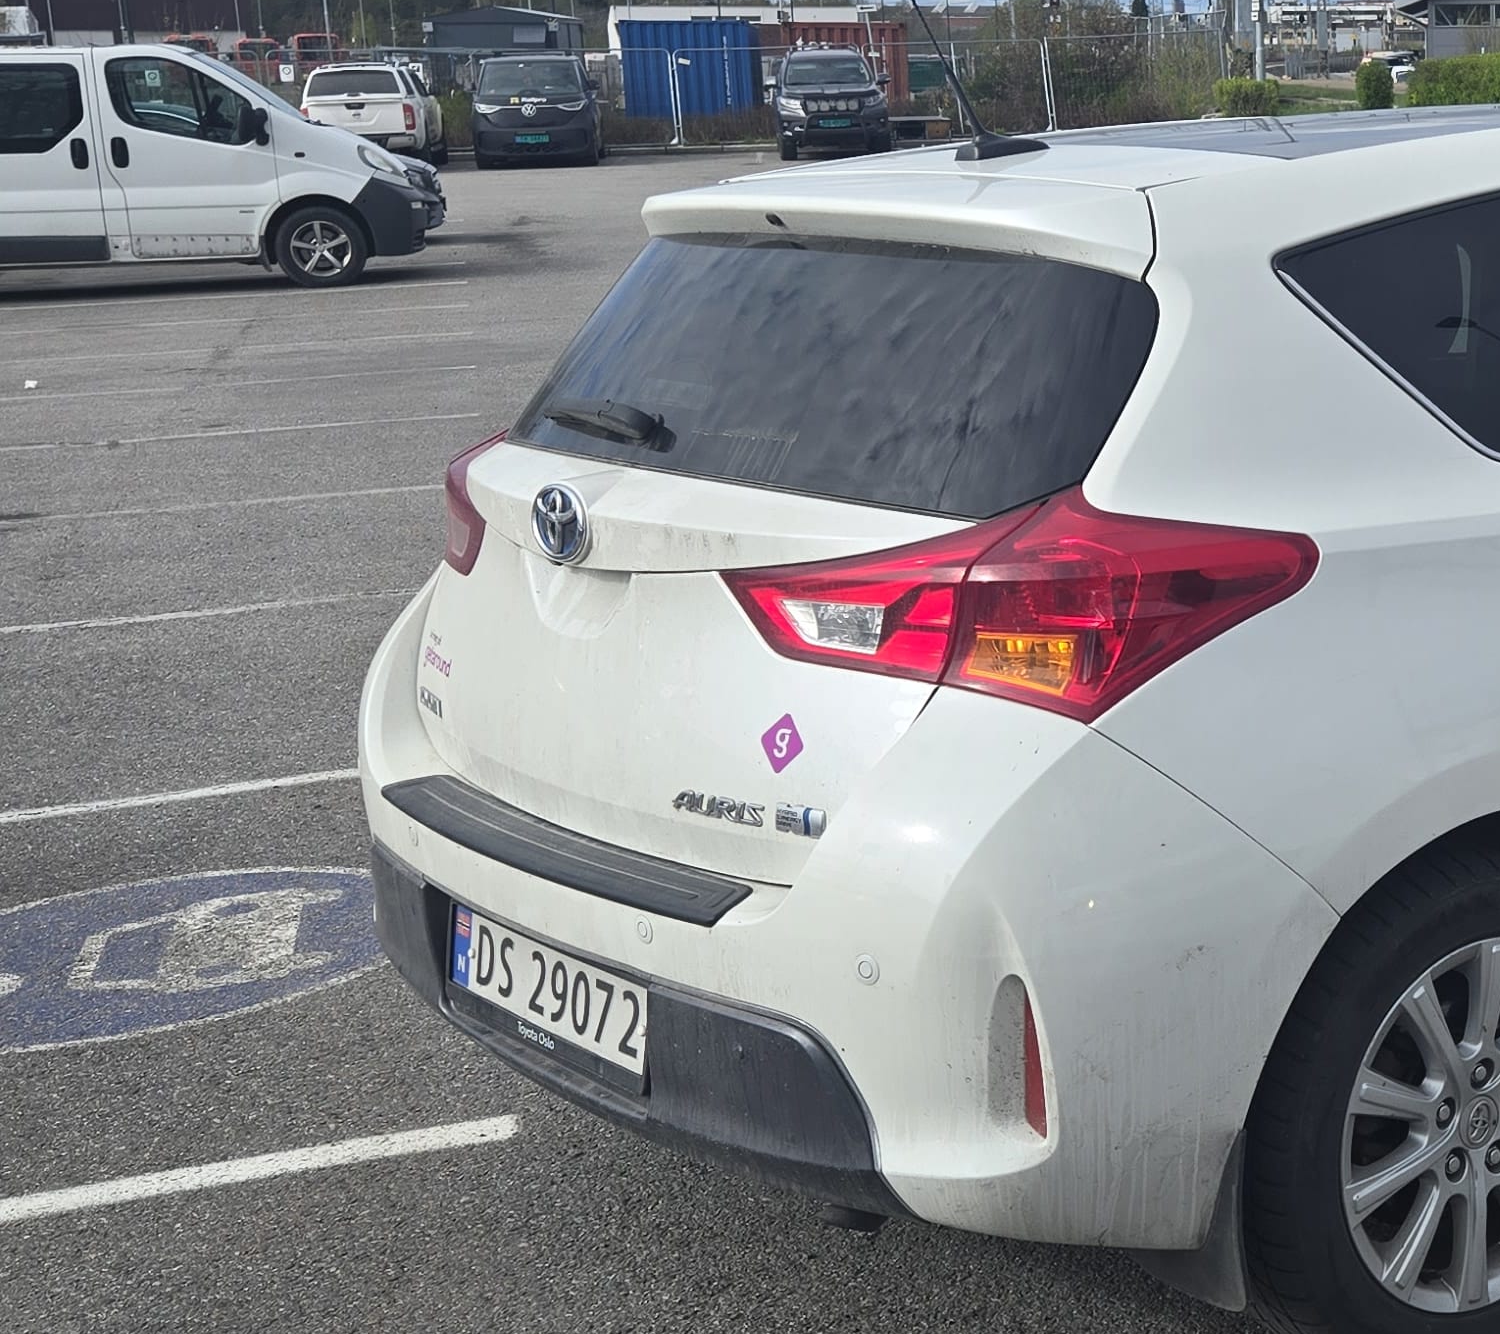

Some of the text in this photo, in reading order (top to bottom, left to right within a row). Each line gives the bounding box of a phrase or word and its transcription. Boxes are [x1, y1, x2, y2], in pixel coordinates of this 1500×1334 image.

[672, 789, 765, 827] AURIS
[457, 953, 465, 973] N
[476, 925, 640, 1059] DS 29072
[517, 1020, 555, 1050] Toyota Oslo
